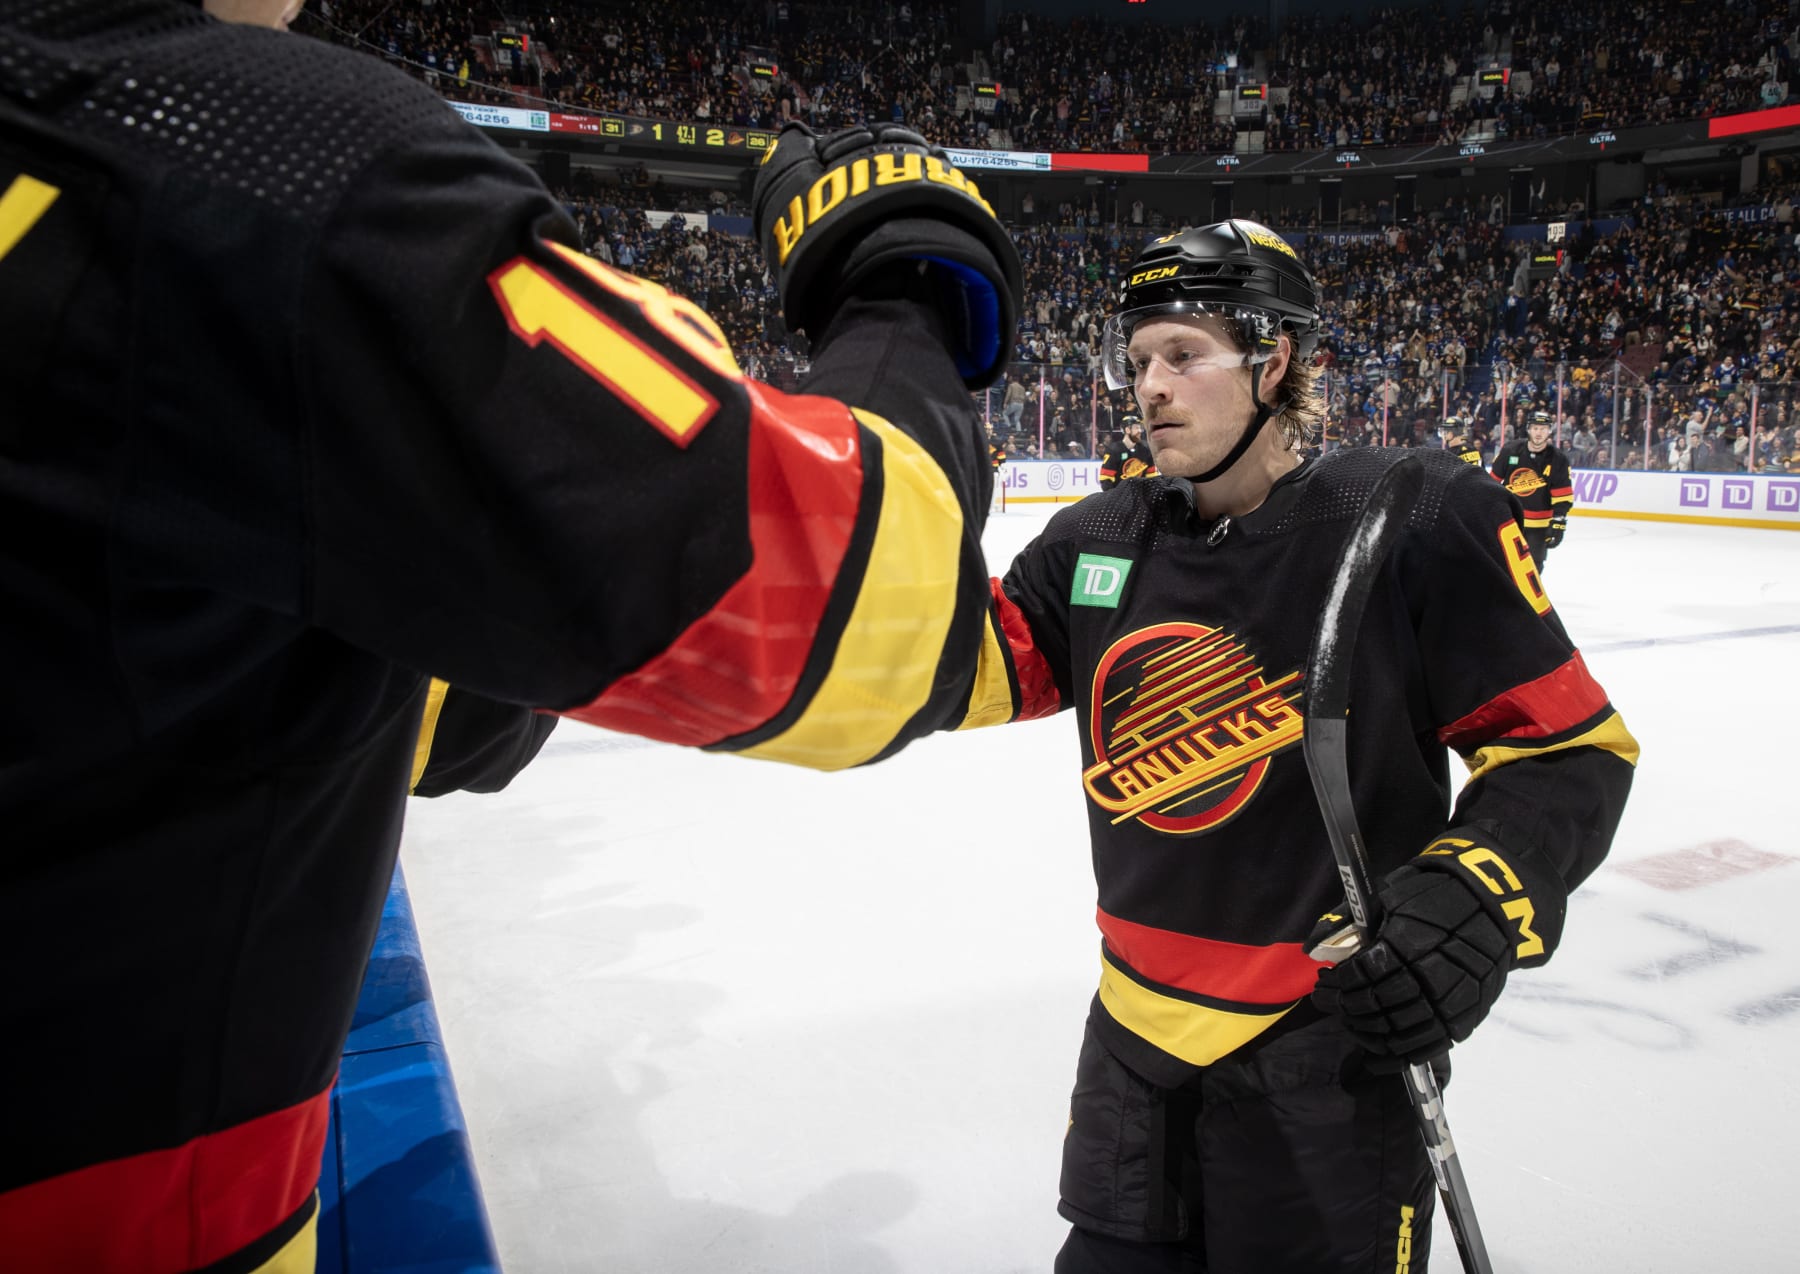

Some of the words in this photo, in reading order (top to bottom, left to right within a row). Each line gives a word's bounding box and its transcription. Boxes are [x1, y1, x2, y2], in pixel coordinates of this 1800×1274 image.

[652, 123, 662, 141] 1
[706, 128, 725, 146] 2
[1590, 135, 1616, 144] ULTRA
[1460, 147, 1485, 155] ULTRA
[1130, 265, 1180, 286] CCM
[1571, 471, 1618, 503] KIP
[1683, 482, 1707, 502] TD
[1725, 484, 1750, 504] TD
[1770, 486, 1797, 507] TD
[1081, 563, 1121, 596] TD
[1338, 864, 1368, 928] CCM
[1419, 838, 1545, 960] CCM
